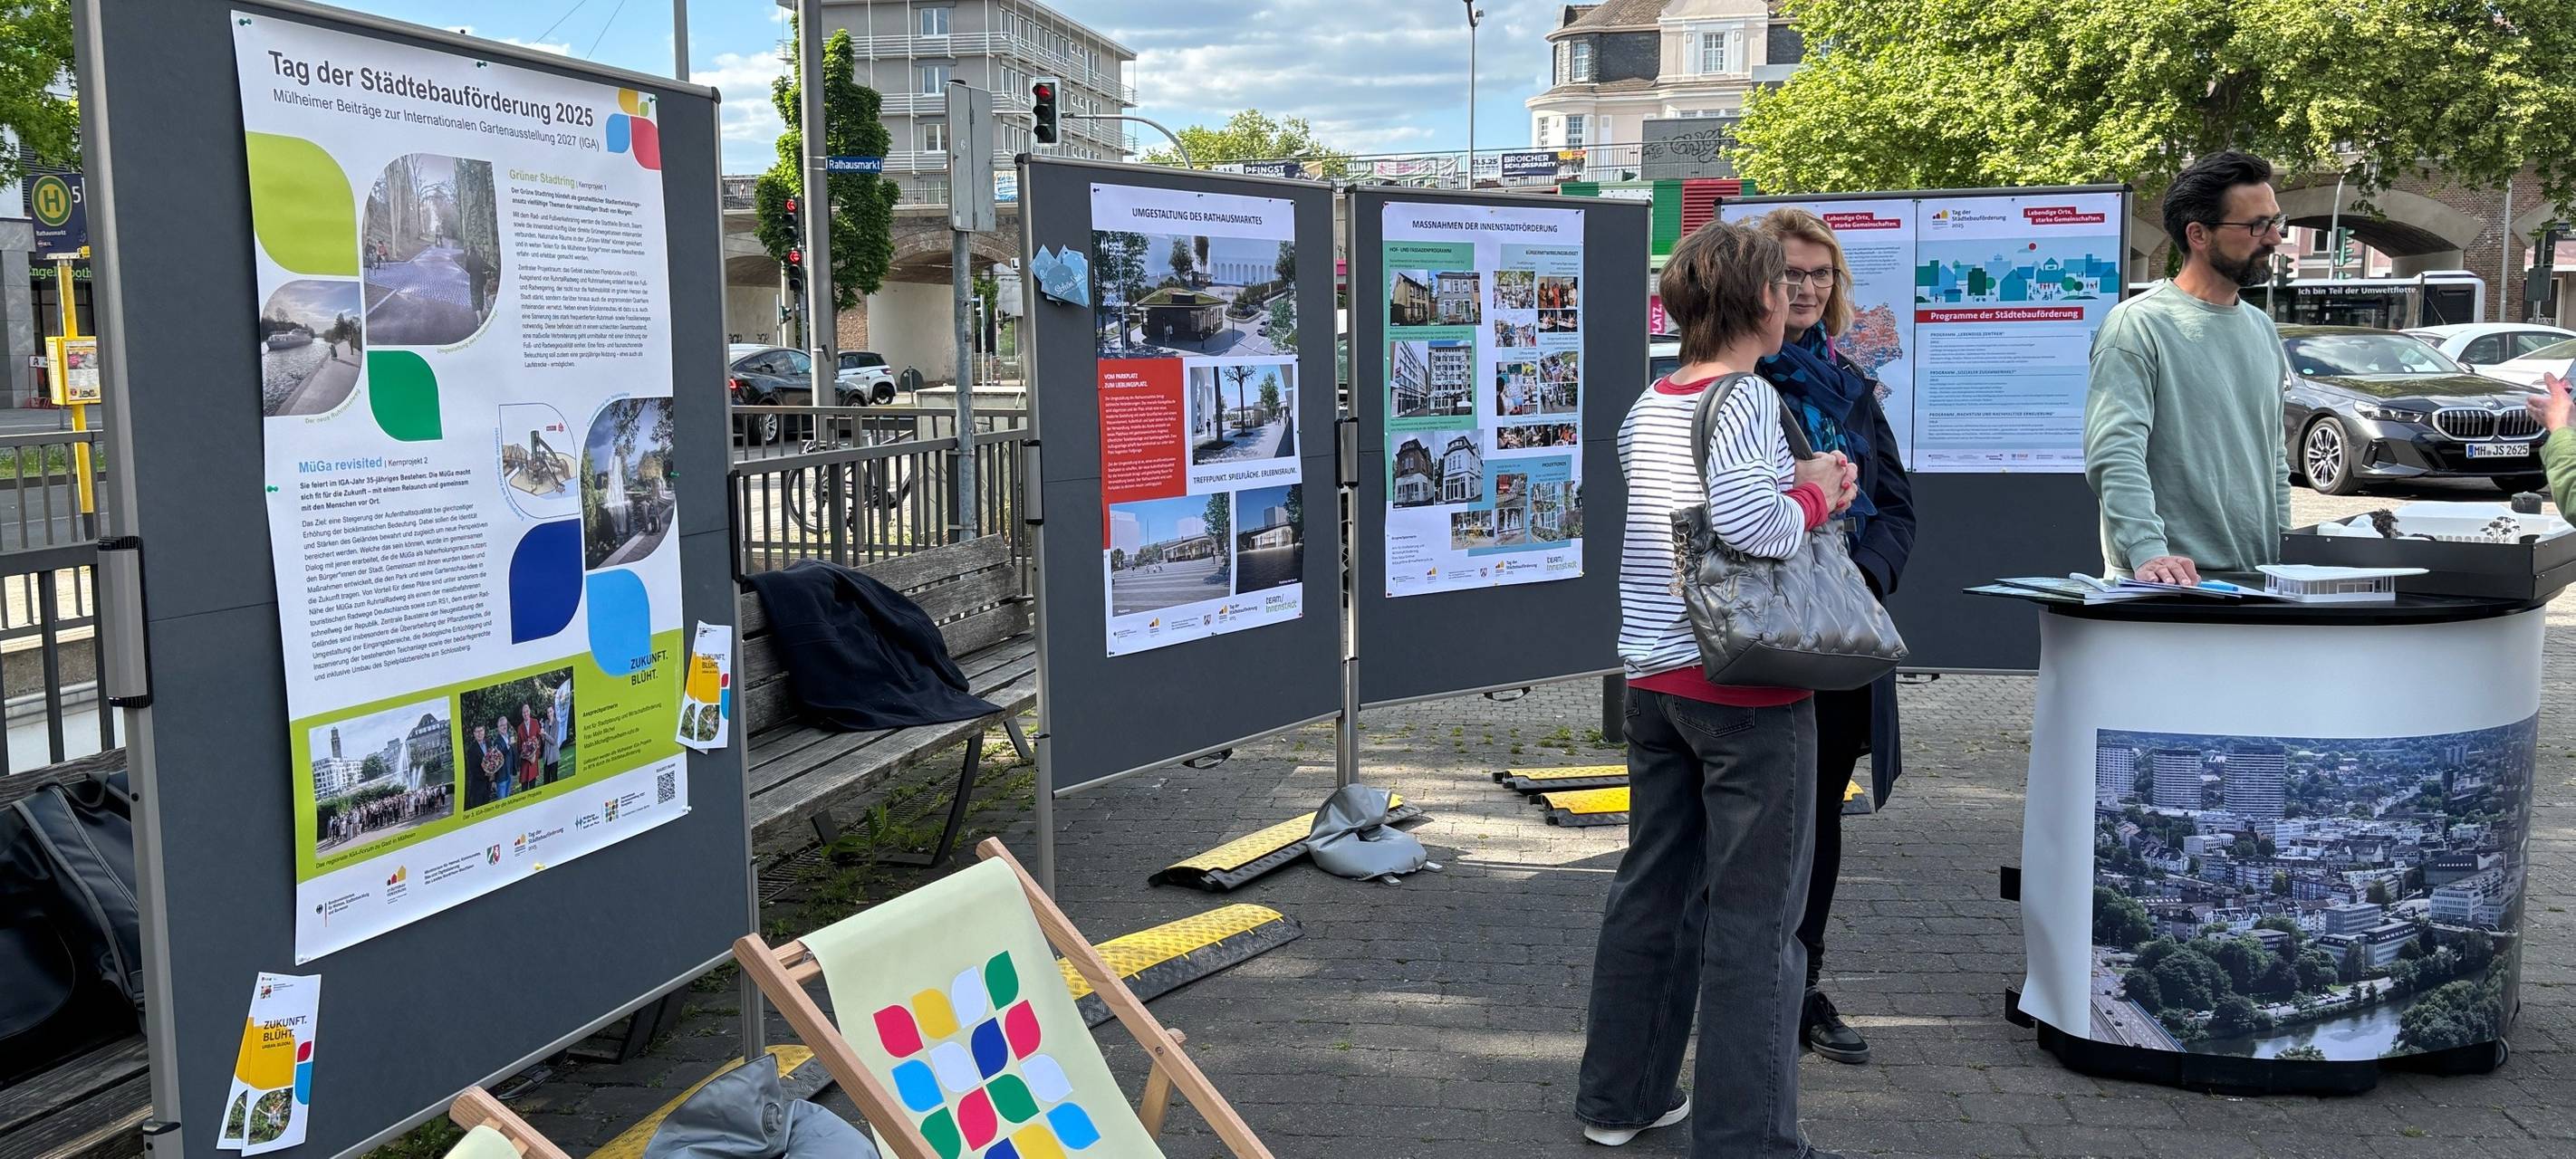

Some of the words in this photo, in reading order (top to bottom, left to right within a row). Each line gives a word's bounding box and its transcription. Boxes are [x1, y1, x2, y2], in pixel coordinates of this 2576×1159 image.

[268, 50, 310, 86] Tag
[317, 60, 354, 87] der
[360, 66, 551, 125] Städtebauförderung
[555, 101, 593, 127] 2025
[273, 88, 333, 110] Mülheimer
[336, 98, 381, 120] Beiträge
[384, 109, 400, 120] zur
[403, 109, 477, 131] Internationalen
[478, 120, 555, 146] Gartenausstellung
[556, 133, 576, 146] 2027
[579, 137, 600, 152] (IGA)
[828, 158, 880, 170] Rathausmarkt
[1504, 155, 1549, 163] BROICHER
[1504, 161, 1556, 169] SCHLOSSPARTY
[1245, 165, 1285, 174] PFINGST
[509, 169, 537, 182] Grüner
[540, 173, 575, 189] Stadtring
[43, 189, 61, 213] H
[72, 186, 82, 204] 5
[1131, 207, 1188, 221] UMGESTALTUNG
[1189, 211, 1202, 222] DES
[1203, 213, 1263, 225] RATHAUSMARKTES
[1826, 215, 1855, 224] Lebendige
[1855, 214, 1870, 222] Orte,
[1951, 214, 2006, 223] Städtebauförderung
[2027, 209, 2057, 217] Lebendige
[2053, 215, 2102, 224] Gemeinschaften.
[1412, 220, 1464, 230] MASSNAHMEN
[1465, 222, 1478, 230] DER
[1480, 221, 1558, 233] INNENSTADTFÖRDERUNG
[1851, 220, 1898, 228] Gemeinschaften.
[2298, 287, 2311, 295] Ich
[2312, 287, 2326, 295] bin
[2329, 287, 2343, 295] Teil
[2360, 285, 2417, 294] Umweltflotte
[1652, 303, 1663, 334] LATZ.
[1930, 311, 1978, 321] Programme
[1979, 311, 1994, 319] der
[1995, 309, 2079, 319] Städtebauförderung
[2474, 445, 2486, 456] MH
[2493, 445, 2504, 456] JS
[2506, 445, 2528, 455] 2625
[298, 460, 332, 474] MüGa
[334, 455, 382, 471] revisited
[387, 457, 423, 467] Kernprojekt
[423, 456, 428, 465] 2
[299, 482, 311, 490] Sie
[311, 480, 329, 488] feiert
[337, 477, 365, 486] IGA-Jahr
[366, 474, 399, 484] 35-jähriges
[399, 473, 428, 481] Bestehen:
[454, 468, 471, 476] macht
[1193, 474, 1227, 484] TREFFPUNKT.
[1228, 470, 1261, 481] SPIELFLÄCHE.
[1261, 466, 1297, 477] ERLEBNISRAUM.
[300, 493, 314, 501] sich
[332, 490, 342, 498] die
[342, 487, 367, 497] Zukunft
[400, 483, 428, 491] Relaunch
[428, 481, 438, 489] und
[438, 480, 469, 489] gemeinsam
[301, 503, 312, 512] mit
[312, 503, 325, 511] den
[325, 500, 357, 509] Menschen
[368, 497, 380, 505] Ort.
[301, 520, 313, 528] Das
[328, 517, 341, 525] eine
[341, 514, 373, 523] Steigerung
[630, 649, 668, 670] ZUKUNFT.
[631, 669, 658, 685] BLÜHT.
[316, 861, 327, 869] Das
[263, 1015, 307, 1030] ZUKUNFT.
[263, 1029, 295, 1042] BLÜHT.
